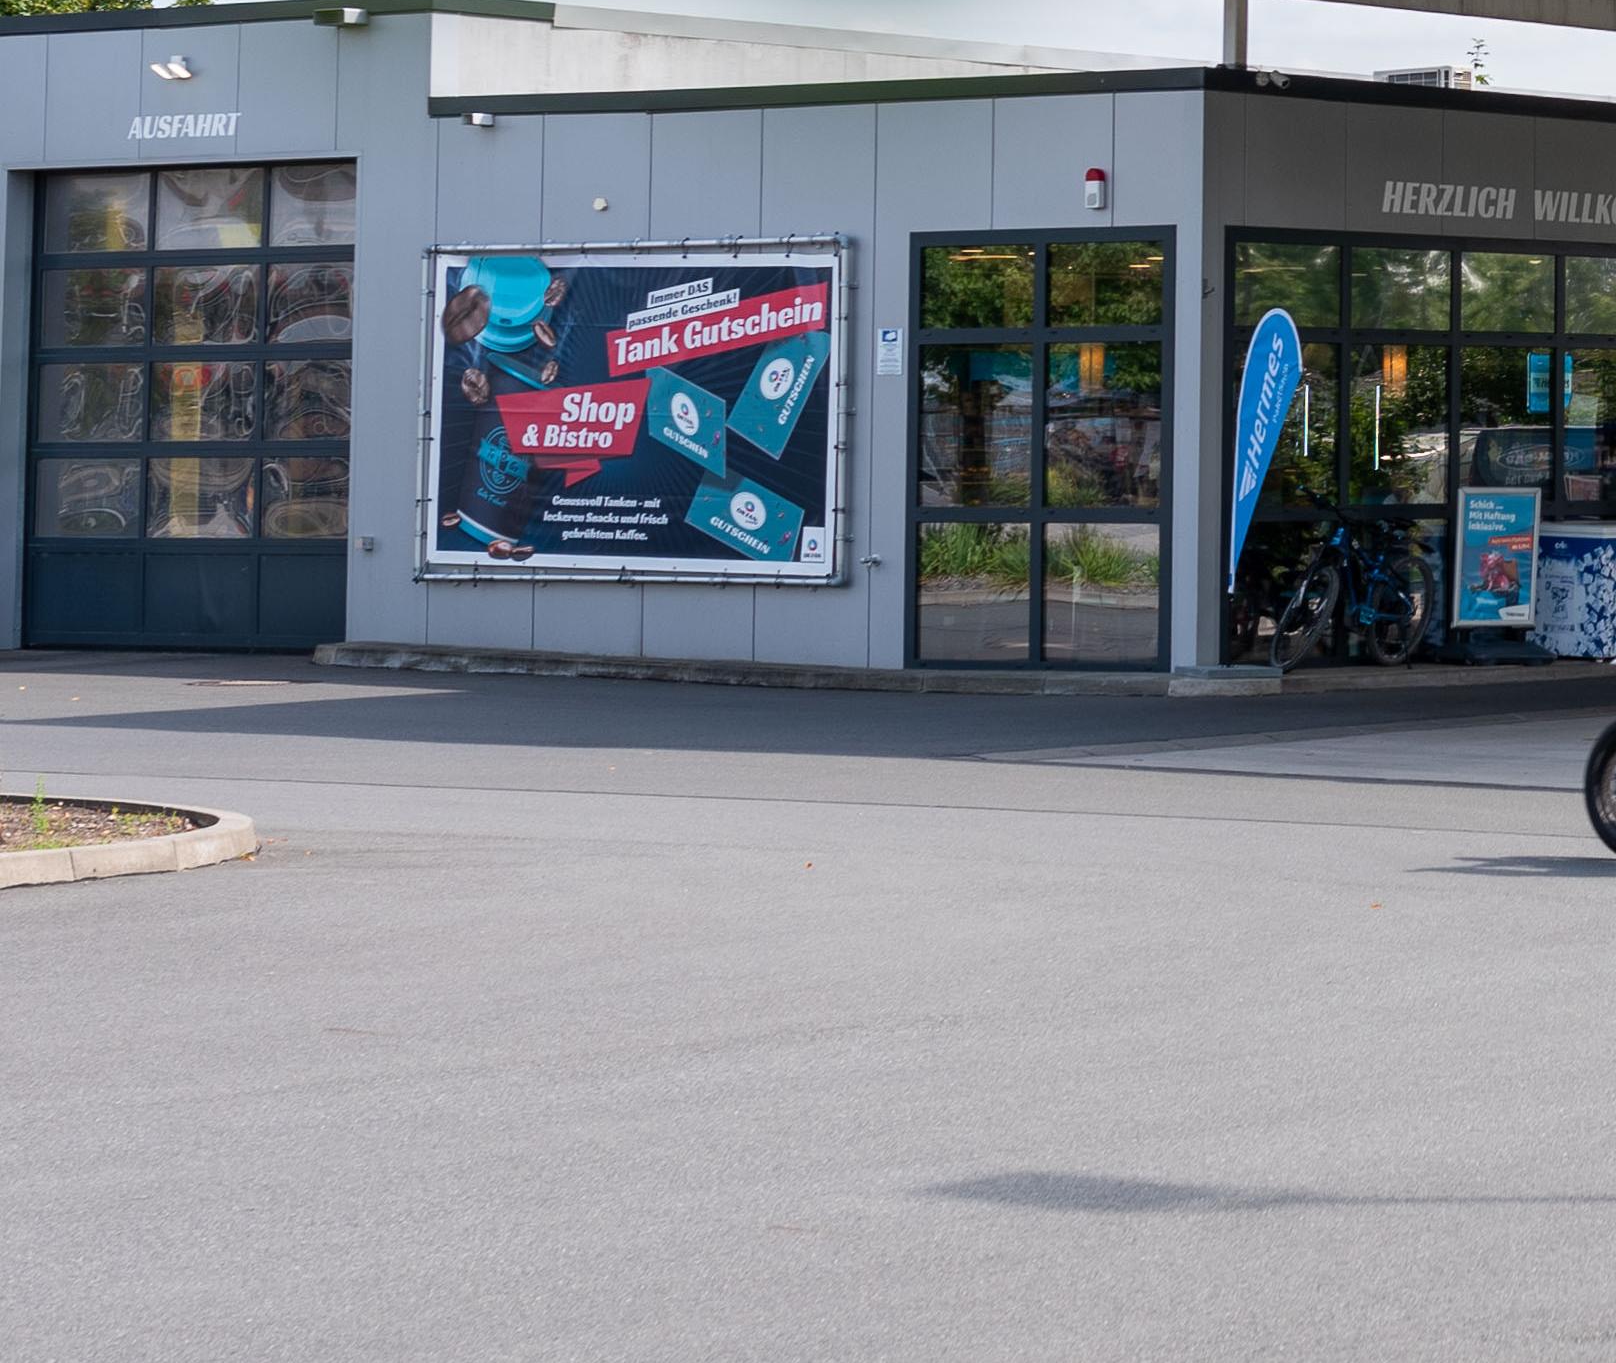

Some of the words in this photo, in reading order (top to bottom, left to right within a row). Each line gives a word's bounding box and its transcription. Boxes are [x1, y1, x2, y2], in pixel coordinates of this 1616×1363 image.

[128, 112, 242, 140] AUSFAHRT
[1382, 180, 1516, 220] HERZLICH
[628, 309, 678, 330] passende
[681, 293, 737, 315] Geschenk!
[650, 289, 685, 305] Immer
[687, 282, 710, 296] DAS
[614, 330, 678, 366] Tank
[683, 297, 823, 350] Gutschein
[777, 355, 816, 425] GUTSCHEIN
[1247, 333, 1284, 469] Hermes
[560, 391, 636, 429] Shop
[522, 425, 539, 446] &
[543, 425, 614, 448] Bistro
[663, 427, 709, 459] GUTSCHEIN
[543, 510, 585, 522] leckeren
[585, 512, 619, 524] Snacks
[620, 513, 640, 524] und
[639, 513, 668, 525] frisch
[552, 495, 603, 507] Genussvoll
[603, 496, 637, 508] Tanken
[643, 497, 661, 508] mit
[710, 516, 772, 555] GUTSCHEIN
